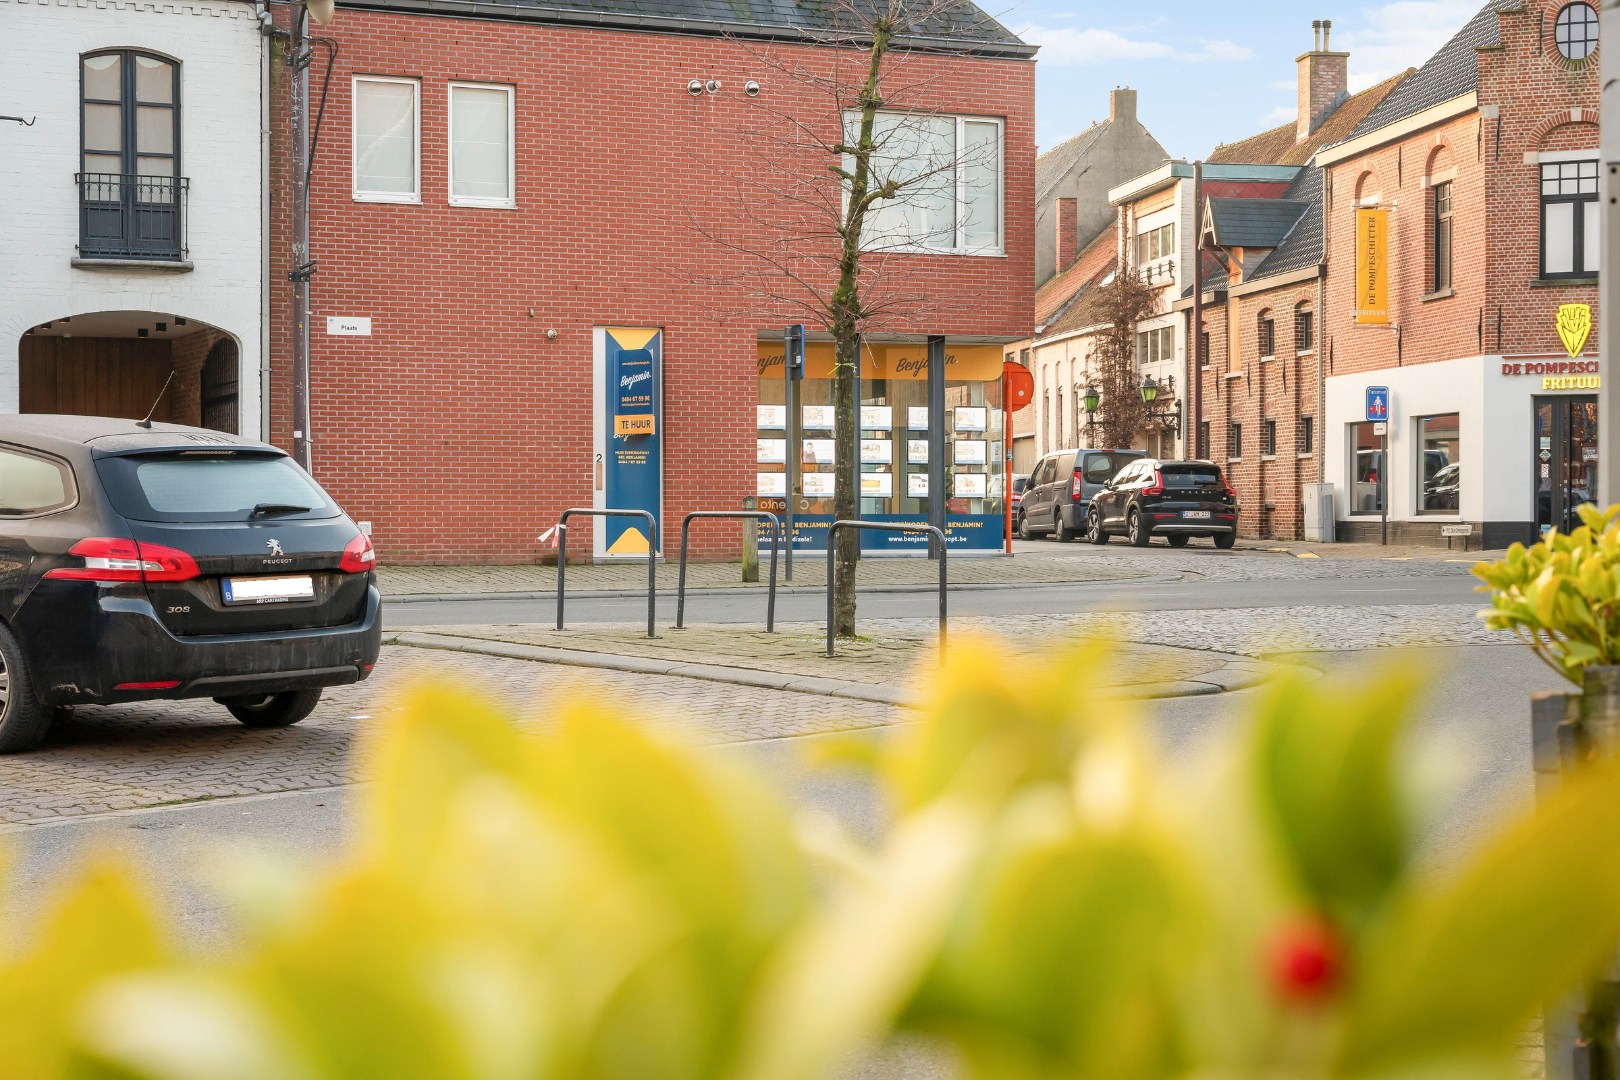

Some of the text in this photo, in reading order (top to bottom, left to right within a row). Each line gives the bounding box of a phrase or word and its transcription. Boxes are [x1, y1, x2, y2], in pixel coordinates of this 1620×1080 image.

[1369, 294, 1375, 305] DE
[1502, 364, 1521, 375] DE
[621, 420, 651, 429] TE HUUR
[596, 454, 602, 463] 2
[226, 592, 231, 600] B
